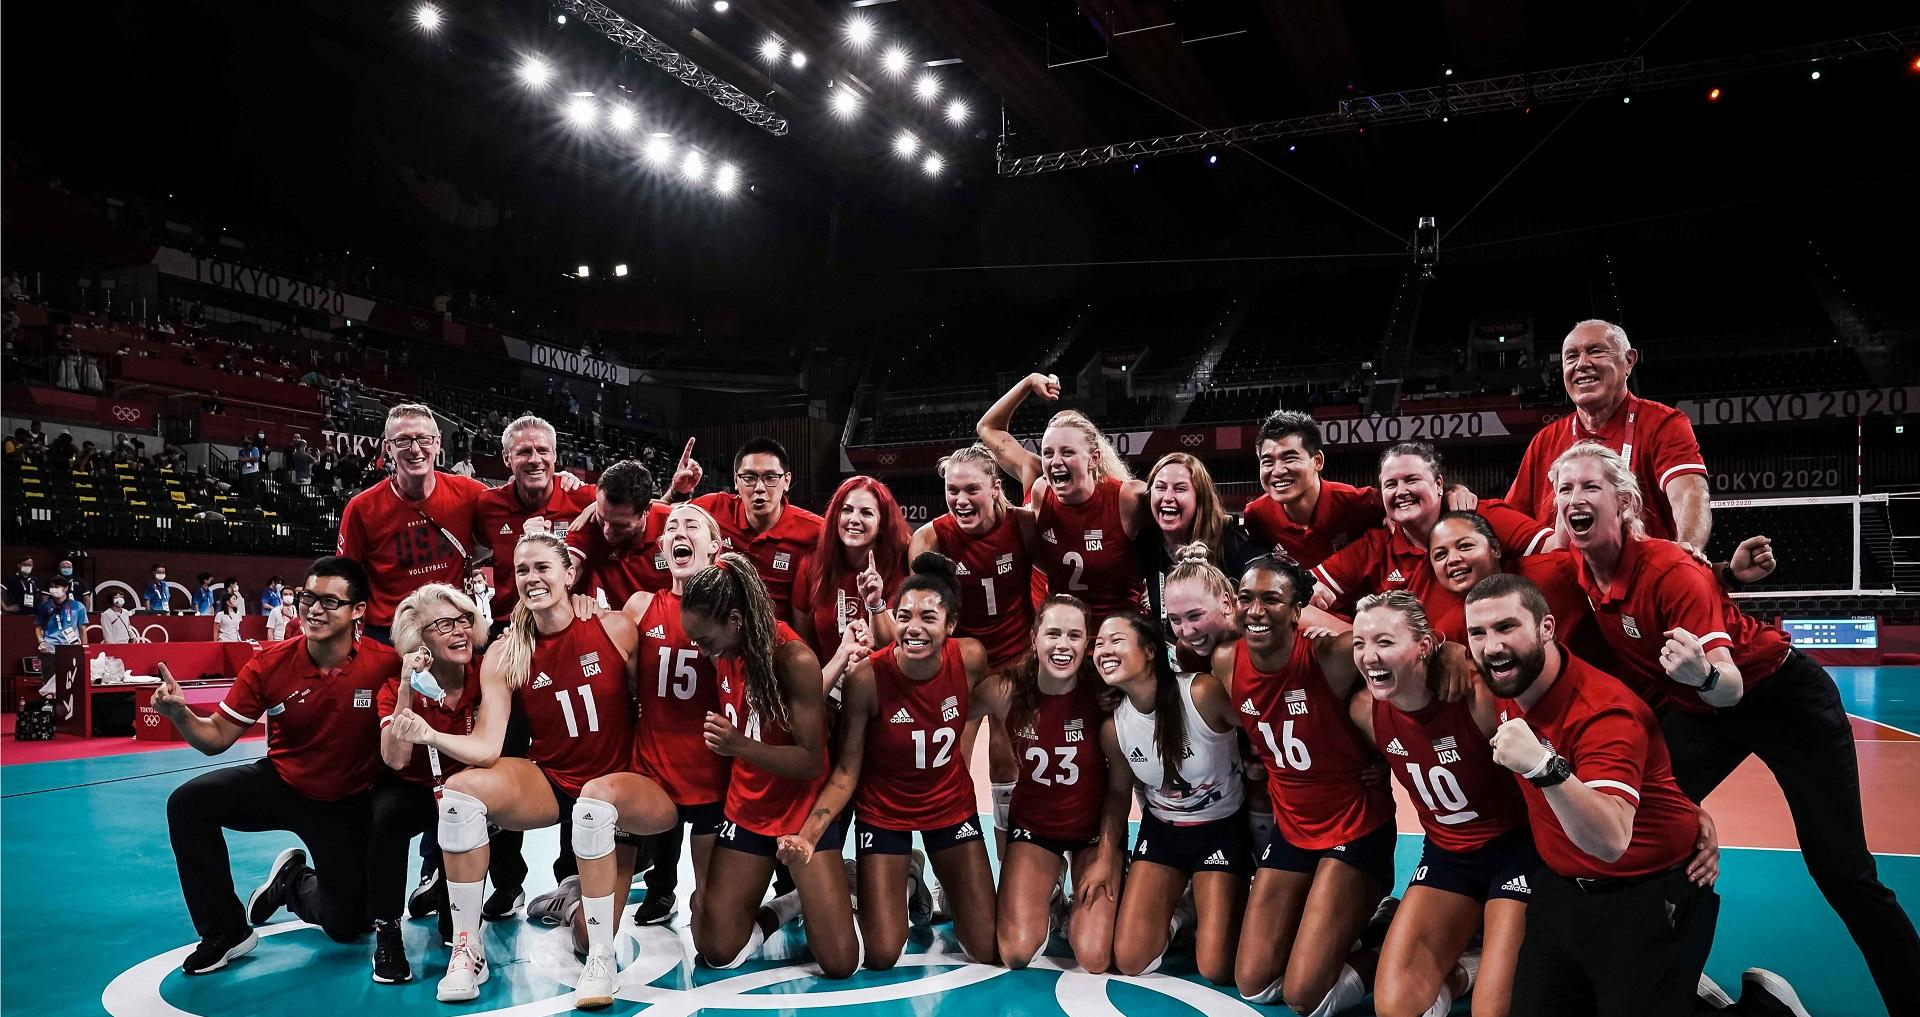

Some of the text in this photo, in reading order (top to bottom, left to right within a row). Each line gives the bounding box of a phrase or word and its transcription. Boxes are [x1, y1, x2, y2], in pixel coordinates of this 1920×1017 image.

[191, 254, 345, 315] TOKYO 2020
[525, 343, 617, 384] TOKYO 2020
[1693, 387, 1907, 427] TOKYO 2020
[1317, 412, 1482, 445] OKYO 2020
[322, 429, 382, 458] TOKY
[1781, 468, 1838, 489] 2020
[900, 505, 927, 519] 020
[1085, 539, 1103, 551] USA
[408, 562, 448, 576] VOLLEYBALL
[997, 562, 1013, 575] USA
[1062, 551, 1089, 591] 2
[981, 577, 998, 616] 1
[582, 662, 603, 678] USA
[657, 646, 699, 701] 15
[531, 679, 553, 690] adidas
[356, 699, 370, 707] USA
[554, 683, 600, 738] 11
[1287, 701, 1309, 716] USA
[942, 706, 960, 722] USA
[1065, 730, 1085, 742] USA
[911, 727, 956, 769] 12
[1182, 746, 1195, 759] SA
[1257, 719, 1312, 771] 16
[1386, 747, 1409, 757] adidas
[1437, 749, 1462, 765] USA
[1025, 746, 1080, 787] 23
[1405, 762, 1469, 812] 10
[719, 820, 737, 841] 24
[954, 829, 979, 840] adidas
[860, 832, 874, 849] 12
[1138, 839, 1148, 855] 4
[1203, 858, 1229, 866] adidas
[1410, 865, 1429, 883] 10
[1501, 882, 1532, 894] adidas
